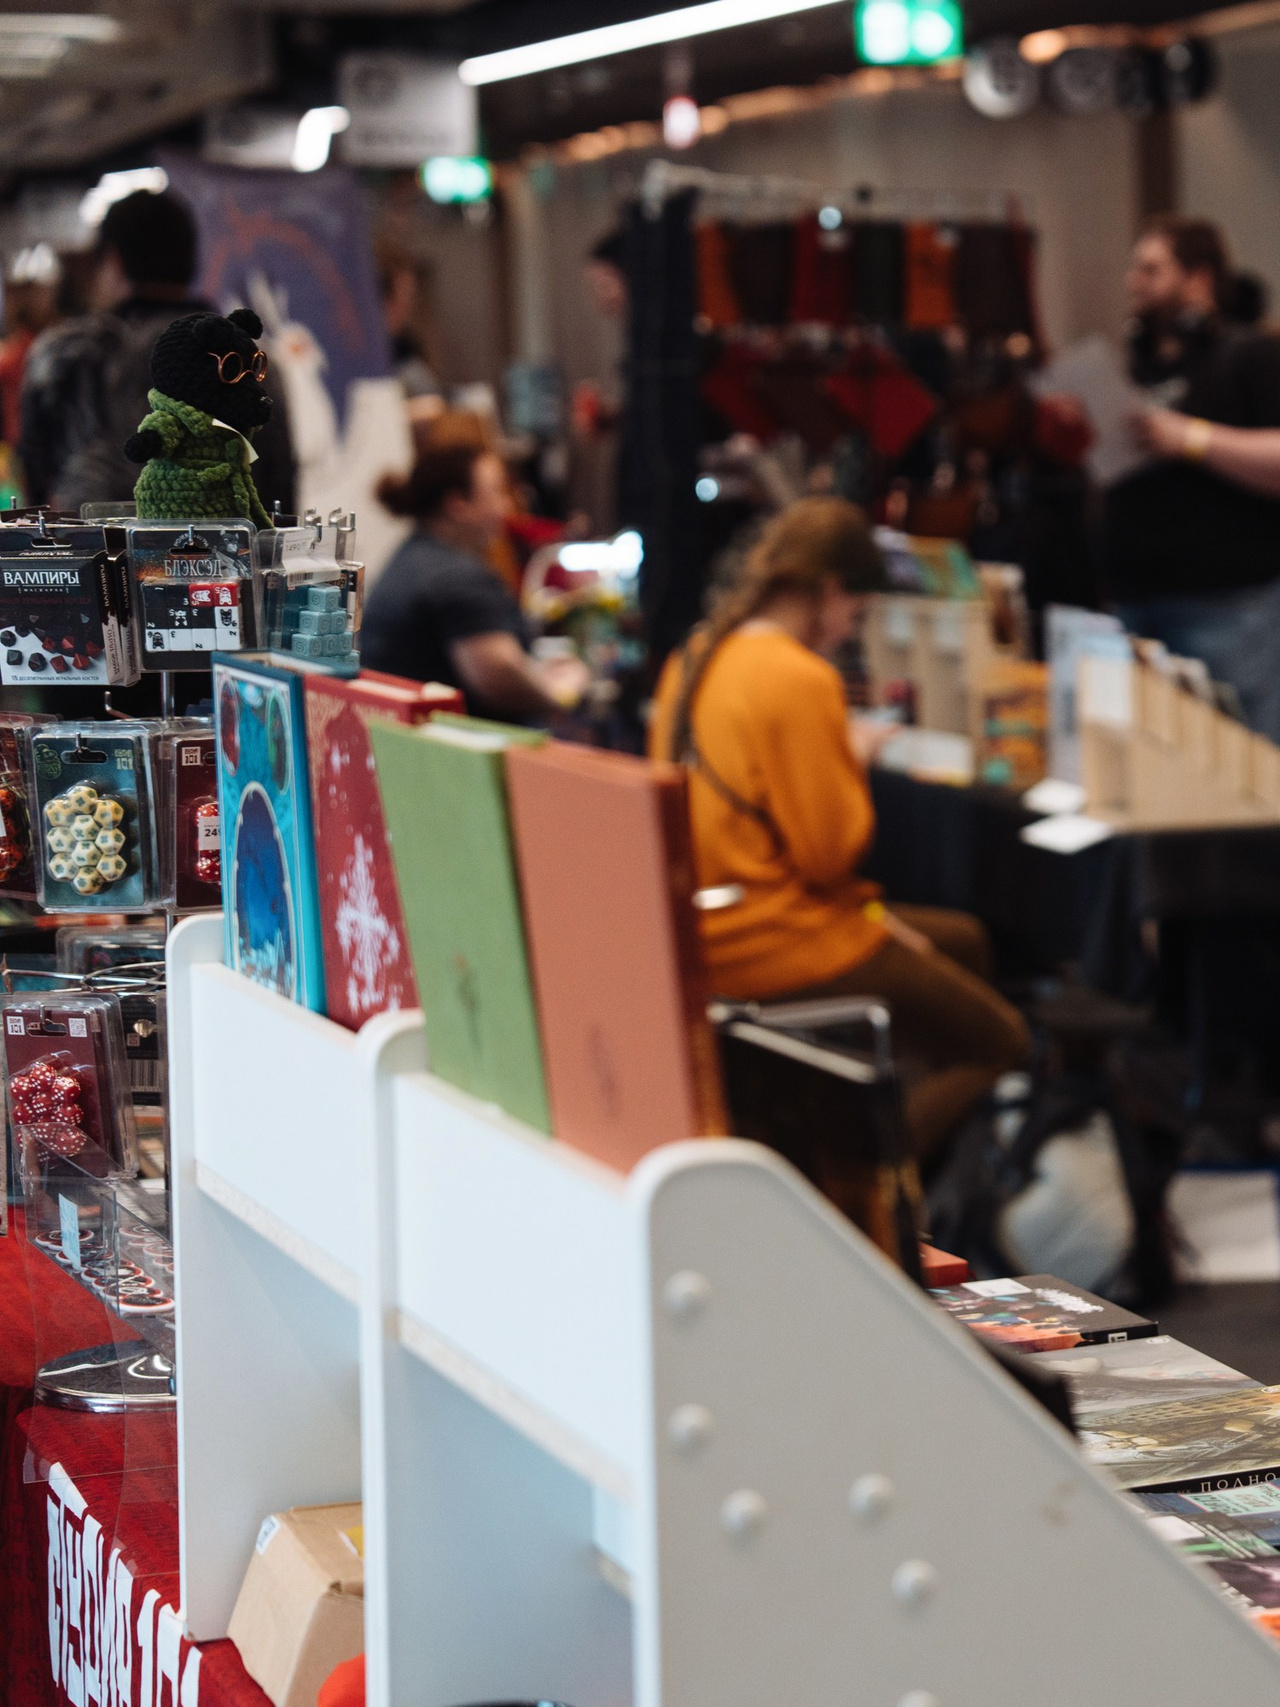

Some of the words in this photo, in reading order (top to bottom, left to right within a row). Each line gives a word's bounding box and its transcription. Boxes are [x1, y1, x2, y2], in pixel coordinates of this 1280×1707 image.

[164, 560, 223, 578] БЛЭКСЭД
[3, 571, 80, 585] ВАМПИРЫ
[117, 758, 134, 770] 101
[185, 755, 198, 764] 101
[10, 1024, 22, 1033] 101
